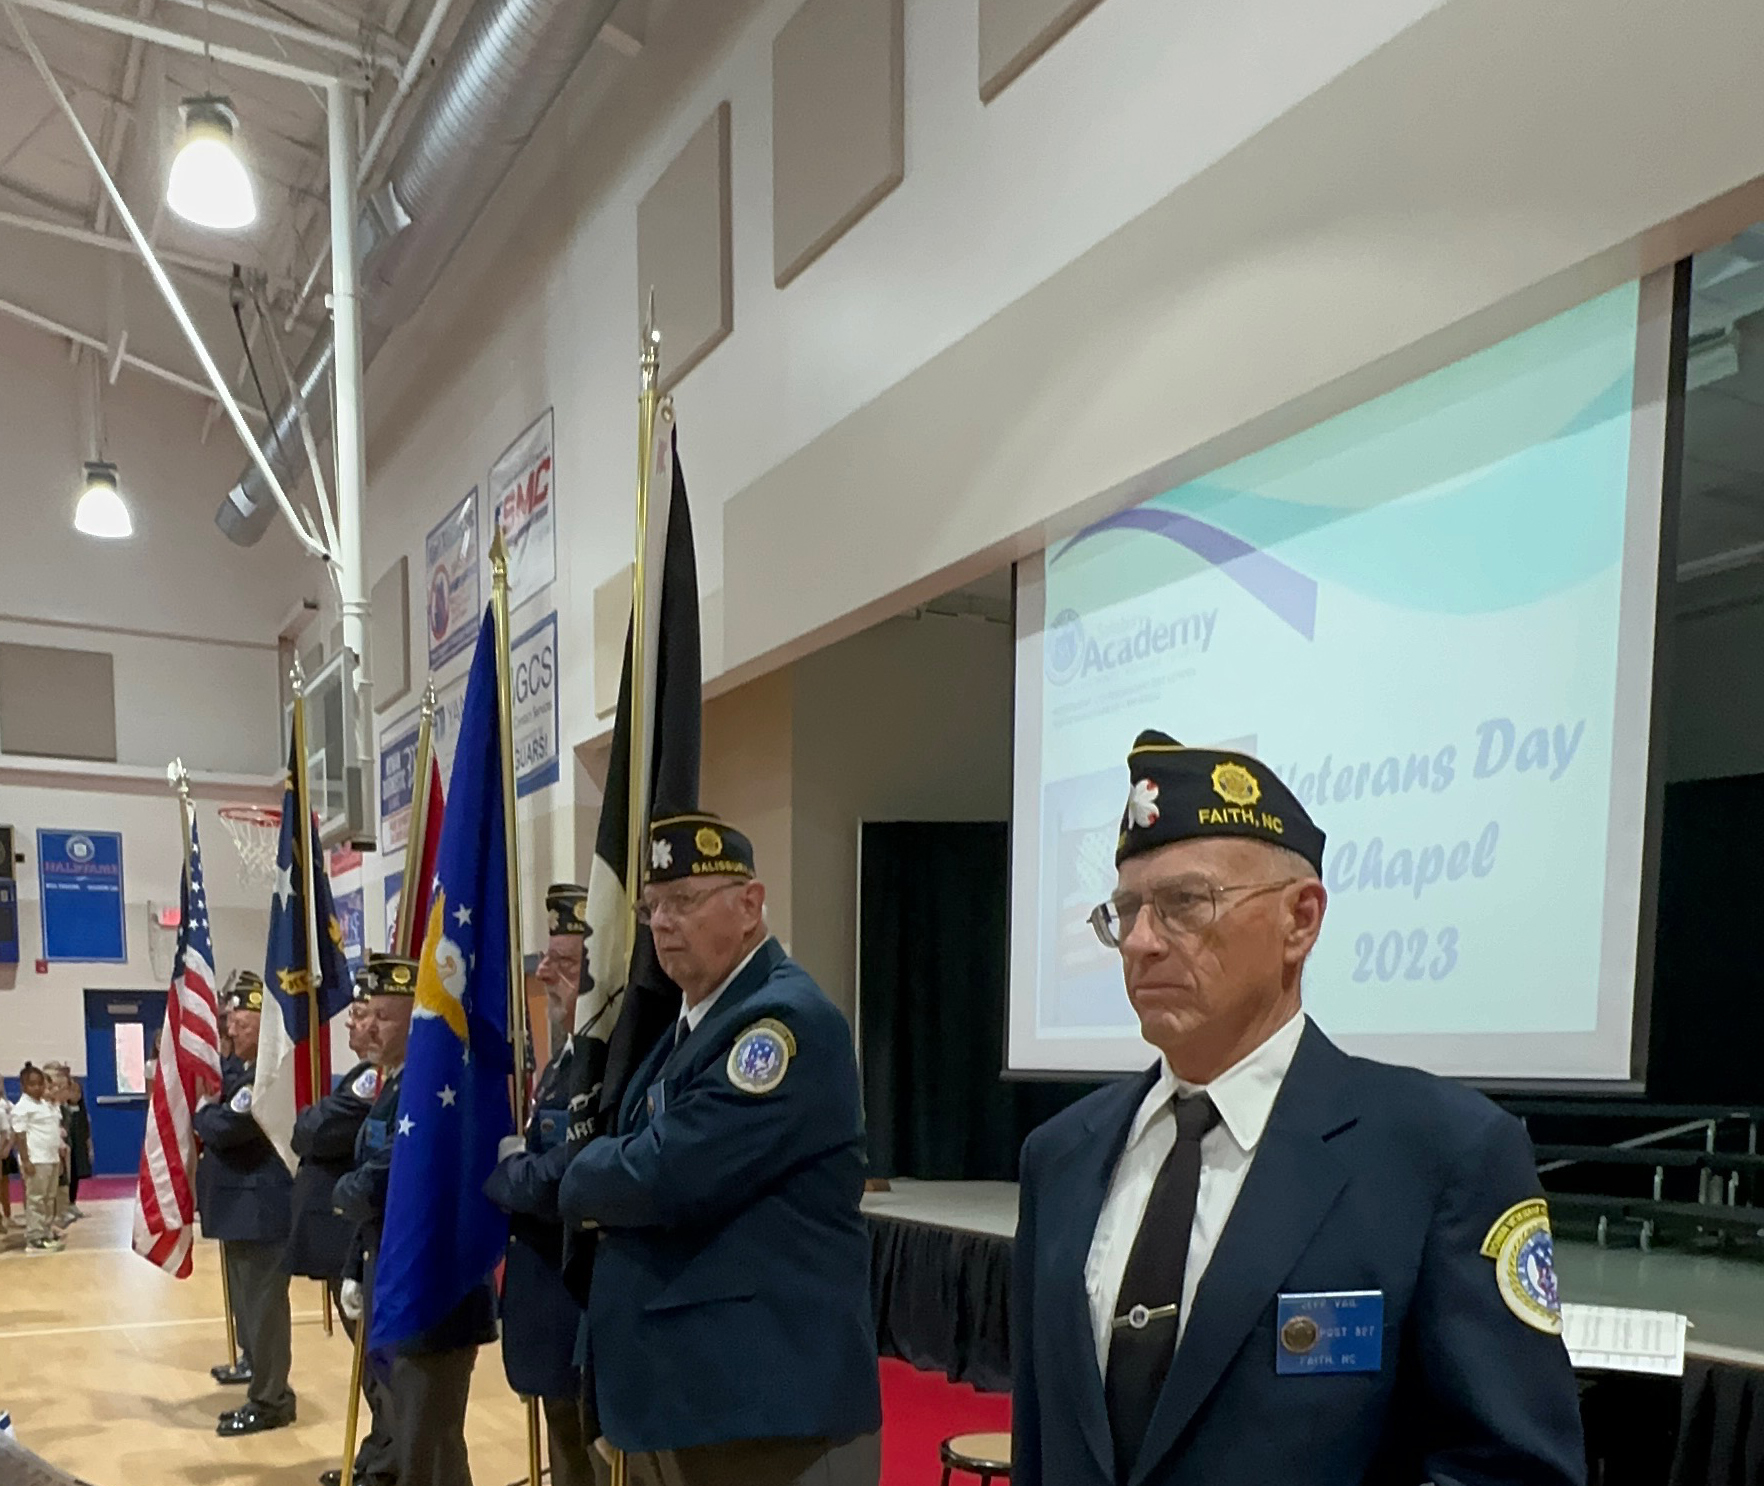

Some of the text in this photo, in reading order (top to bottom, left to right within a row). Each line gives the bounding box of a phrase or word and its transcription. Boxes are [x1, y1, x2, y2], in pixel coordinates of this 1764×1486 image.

[1081, 607, 1218, 678] Academy
[512, 644, 552, 706] GCS
[1473, 717, 1585, 782] Day
[1198, 807, 1285, 835] FAITH, NC
[1327, 820, 1500, 900] Chapel
[1352, 925, 1459, 983] 2023
